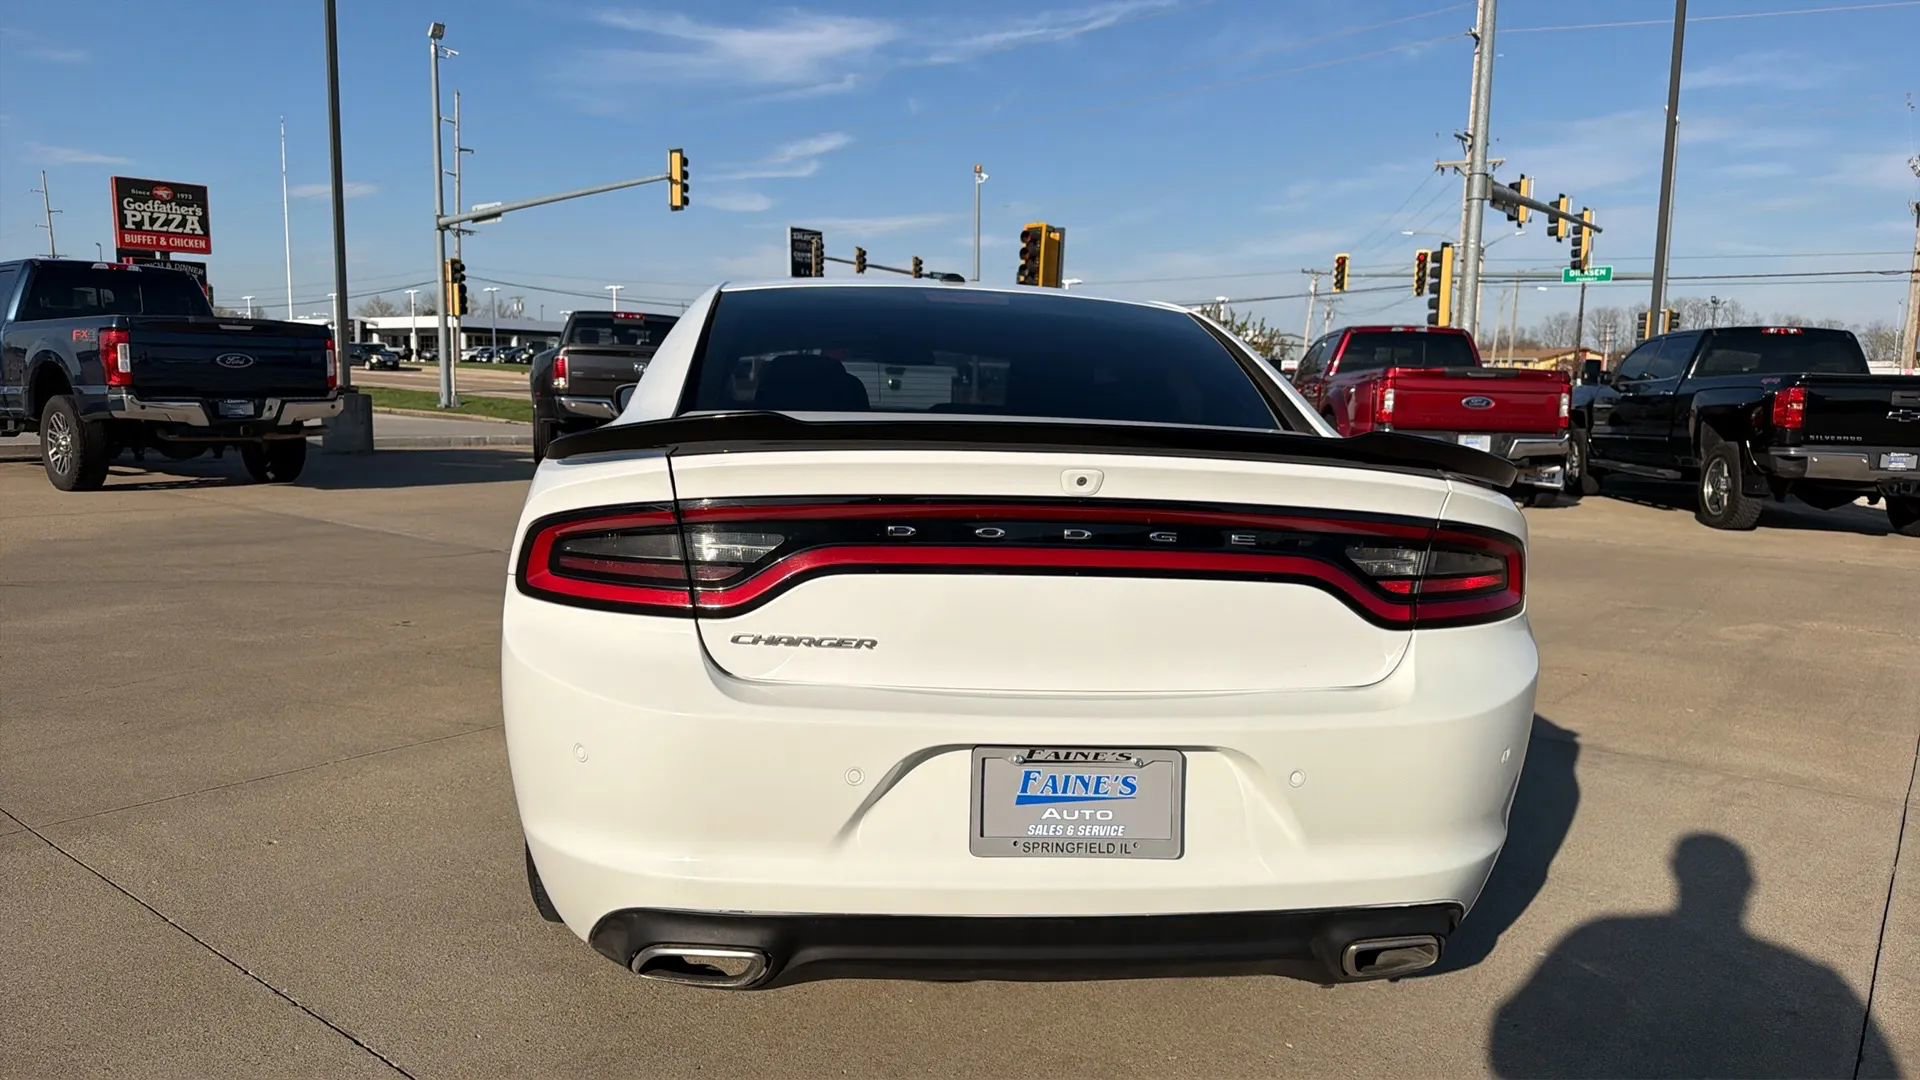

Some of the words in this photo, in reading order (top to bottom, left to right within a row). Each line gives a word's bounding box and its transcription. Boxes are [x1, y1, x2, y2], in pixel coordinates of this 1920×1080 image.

[130, 188, 150, 196] Since
[122, 198, 203, 216] Godfather's
[123, 210, 204, 235] PIZZA
[124, 233, 157, 245] BUFFET
[160, 237, 167, 246] &
[169, 237, 206, 249] CHICKEN
[1809, 434, 1863, 442] SILVERADO
[888, 525, 1257, 545] DODGE
[730, 633, 879, 650] CHARGER
[1026, 749, 1133, 761] FAINE'S
[1018, 769, 1138, 797] FAINE'S
[1040, 808, 1113, 820] AUTO
[1027, 824, 1063, 836] SALES
[1066, 825, 1075, 836] &
[1077, 825, 1126, 837] SERVICE
[1022, 841, 1116, 855] SPRINGFIELD
[1120, 843, 1132, 855] IL
